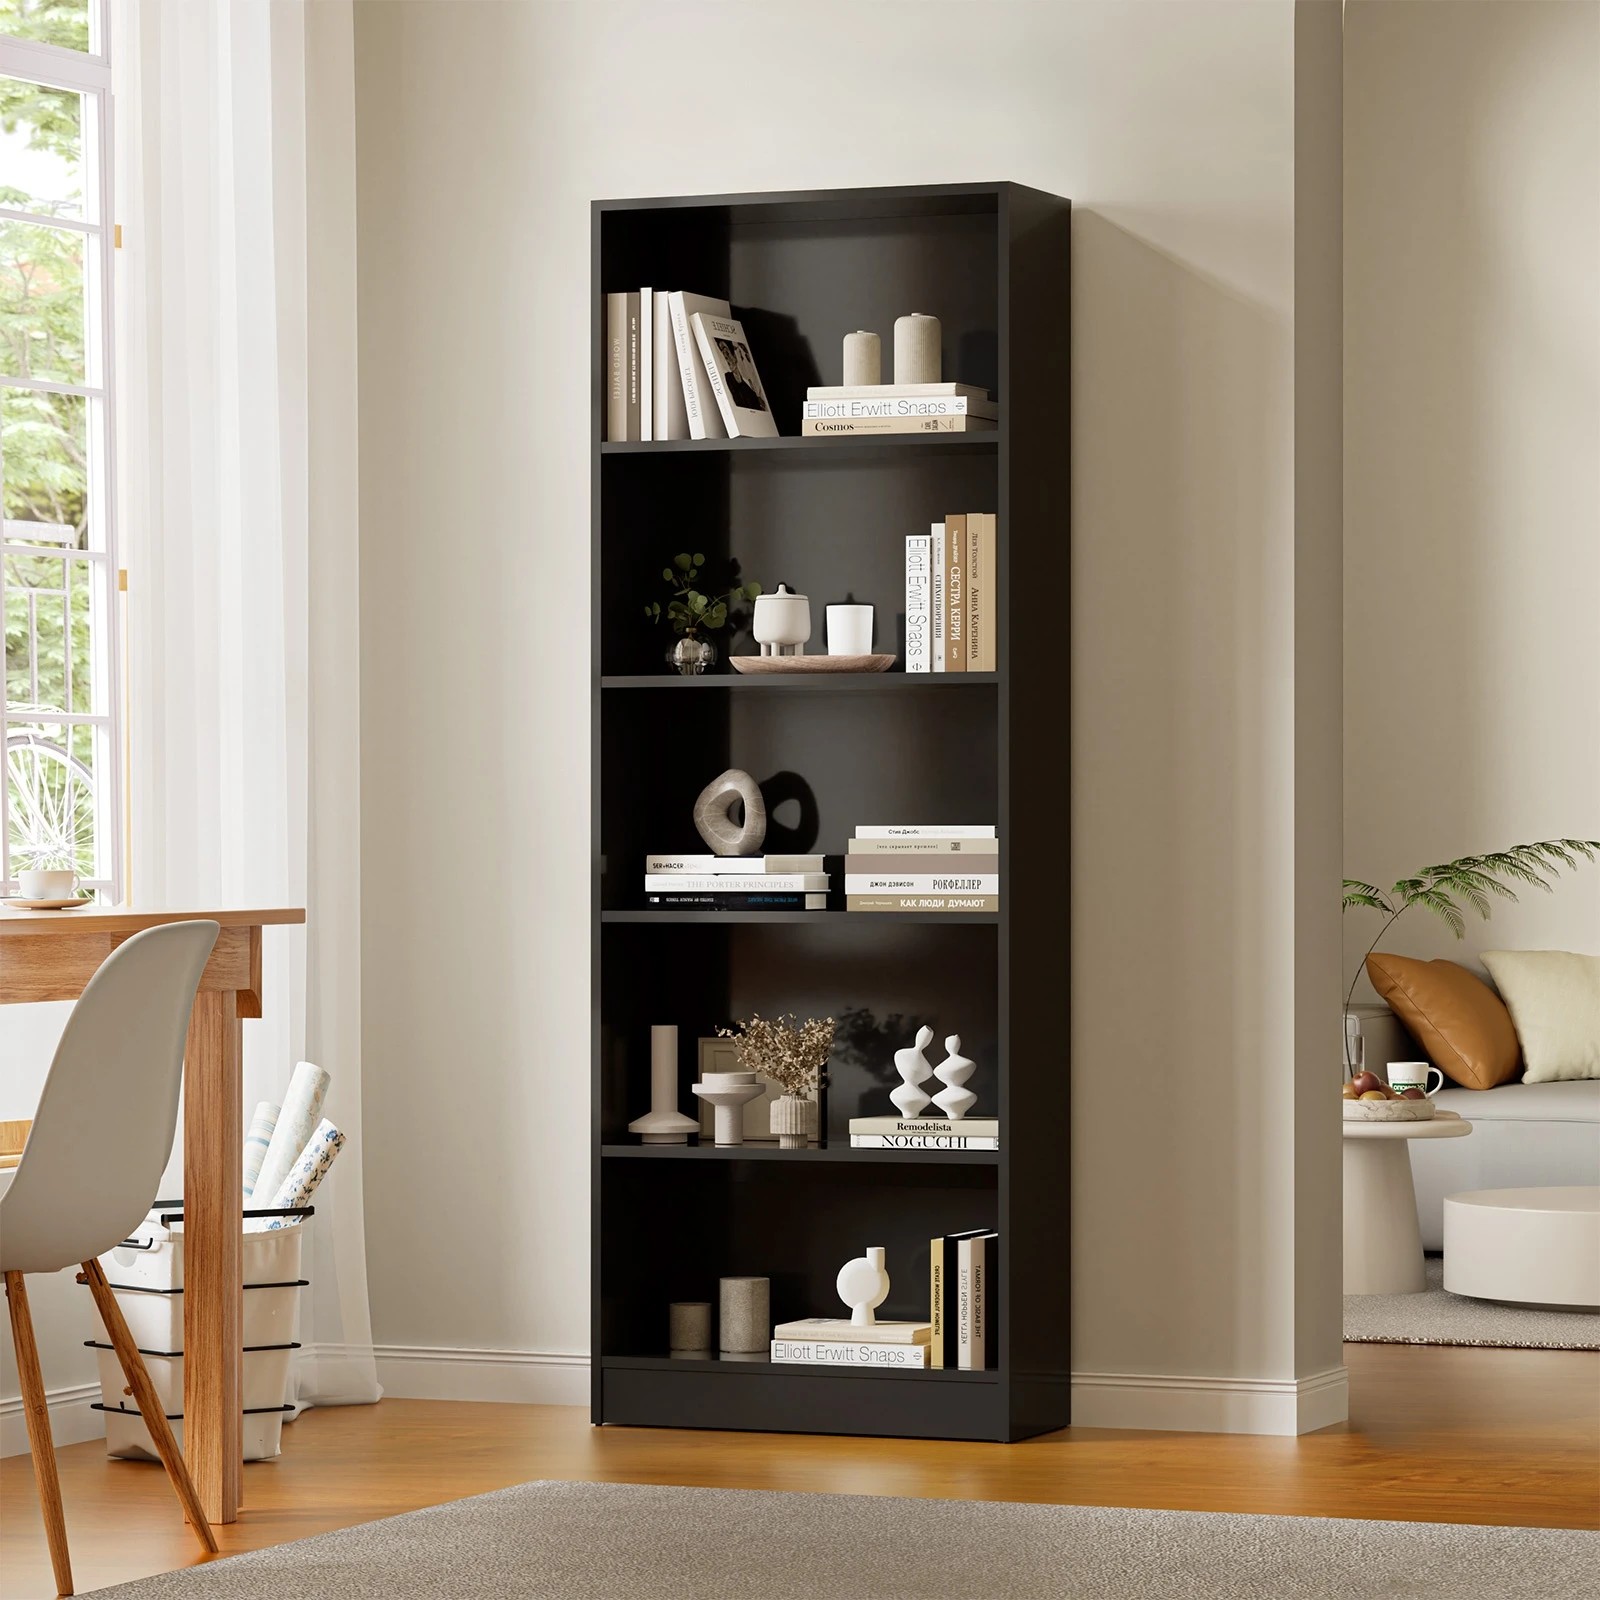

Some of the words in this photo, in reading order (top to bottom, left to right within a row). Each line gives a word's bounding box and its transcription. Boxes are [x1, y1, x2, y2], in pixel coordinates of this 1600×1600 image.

[807, 403, 846, 417] Elliott
[851, 401, 893, 416] Erwitt
[897, 400, 947, 416] Snaps
[815, 422, 855, 432] Cosmos
[908, 538, 927, 572] Elliott
[908, 575, 927, 611] Erwitt
[951, 566, 961, 606] СЕСТРА
[951, 608, 961, 641] КЕРРИ
[907, 614, 927, 656] Snaps
[932, 879, 982, 890] РОКФЕЛЛЕР
[918, 900, 945, 908] ЛЮДИ
[947, 899, 985, 908] ДУМАЮТ
[897, 1122, 952, 1132] Remodelista
[882, 1135, 968, 1149] NOGUCHI
[774, 1343, 811, 1359] Elliott
[816, 1344, 854, 1361] Erwitt
[859, 1346, 905, 1364] Snaps
